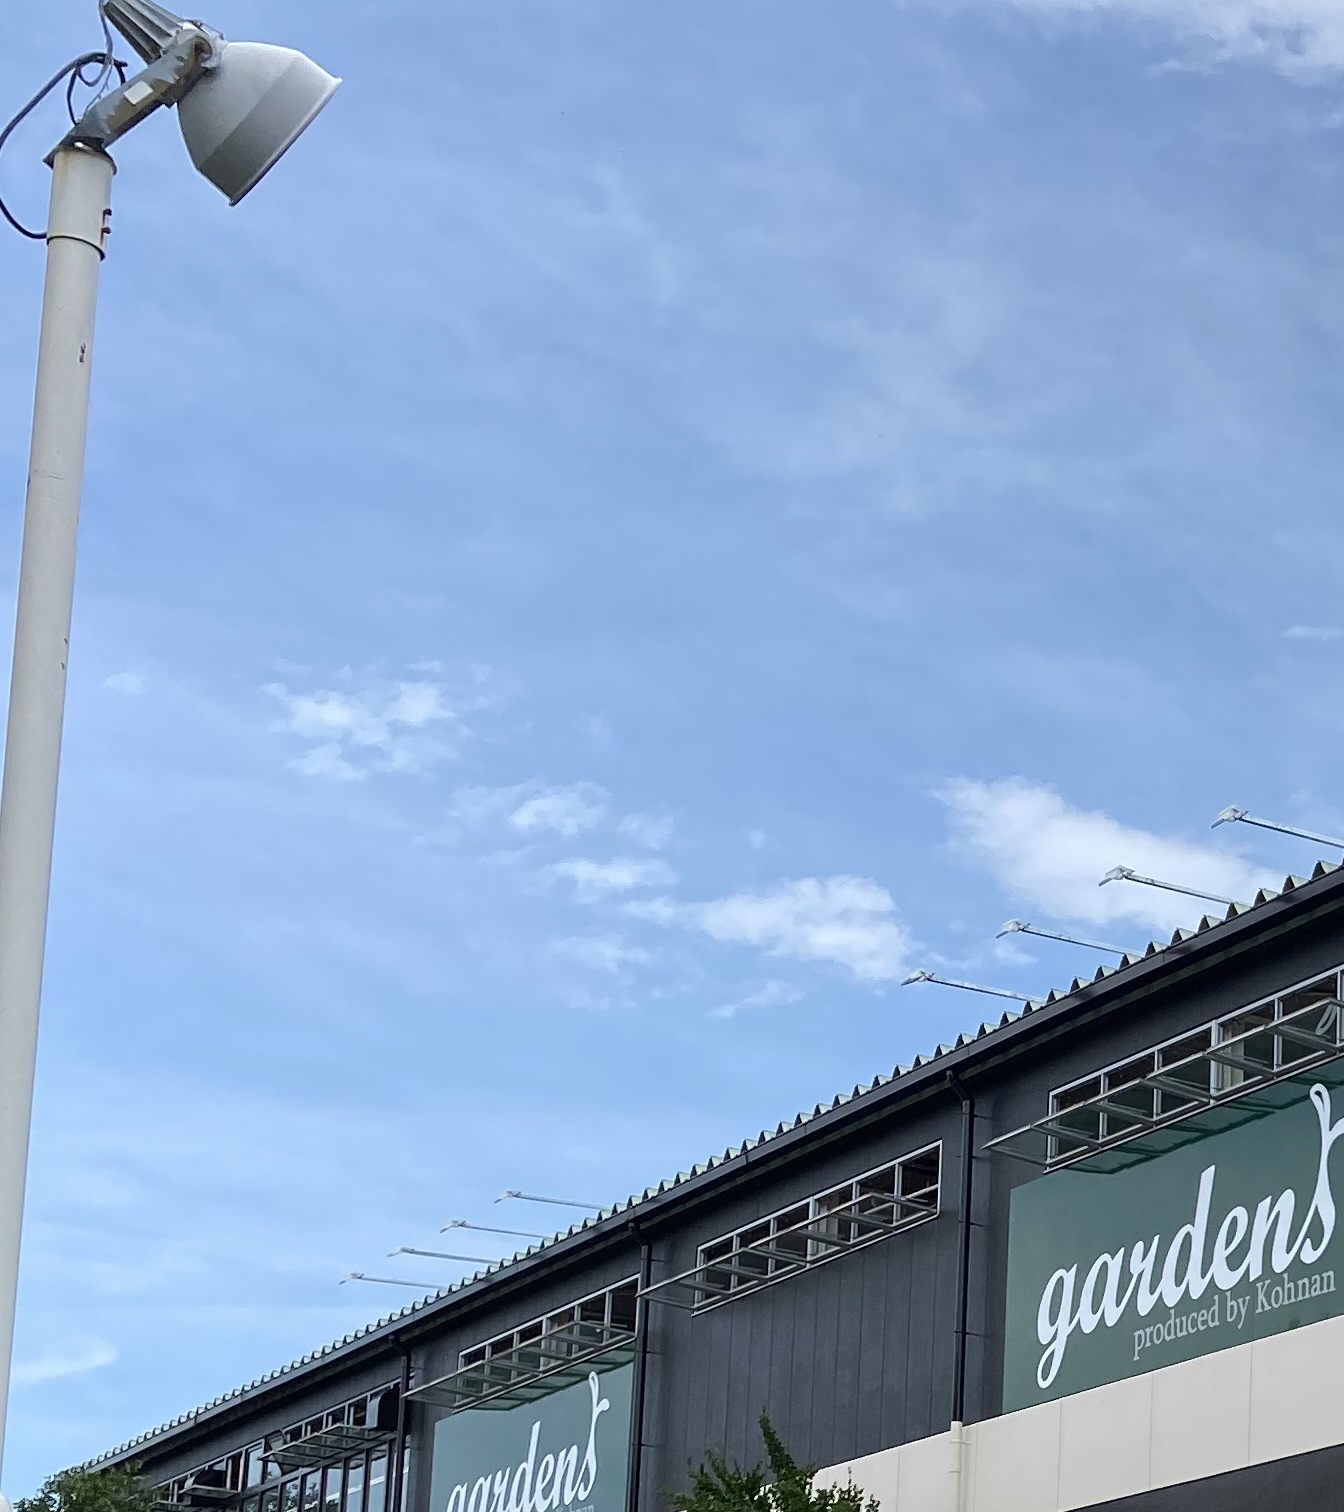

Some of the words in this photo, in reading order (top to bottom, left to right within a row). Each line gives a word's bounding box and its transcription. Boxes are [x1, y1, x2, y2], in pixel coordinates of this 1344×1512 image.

[1132, 1293, 1220, 1361] produced
[1226, 1291, 1251, 1329] by
[1255, 1269, 1337, 1315] Kohnan
